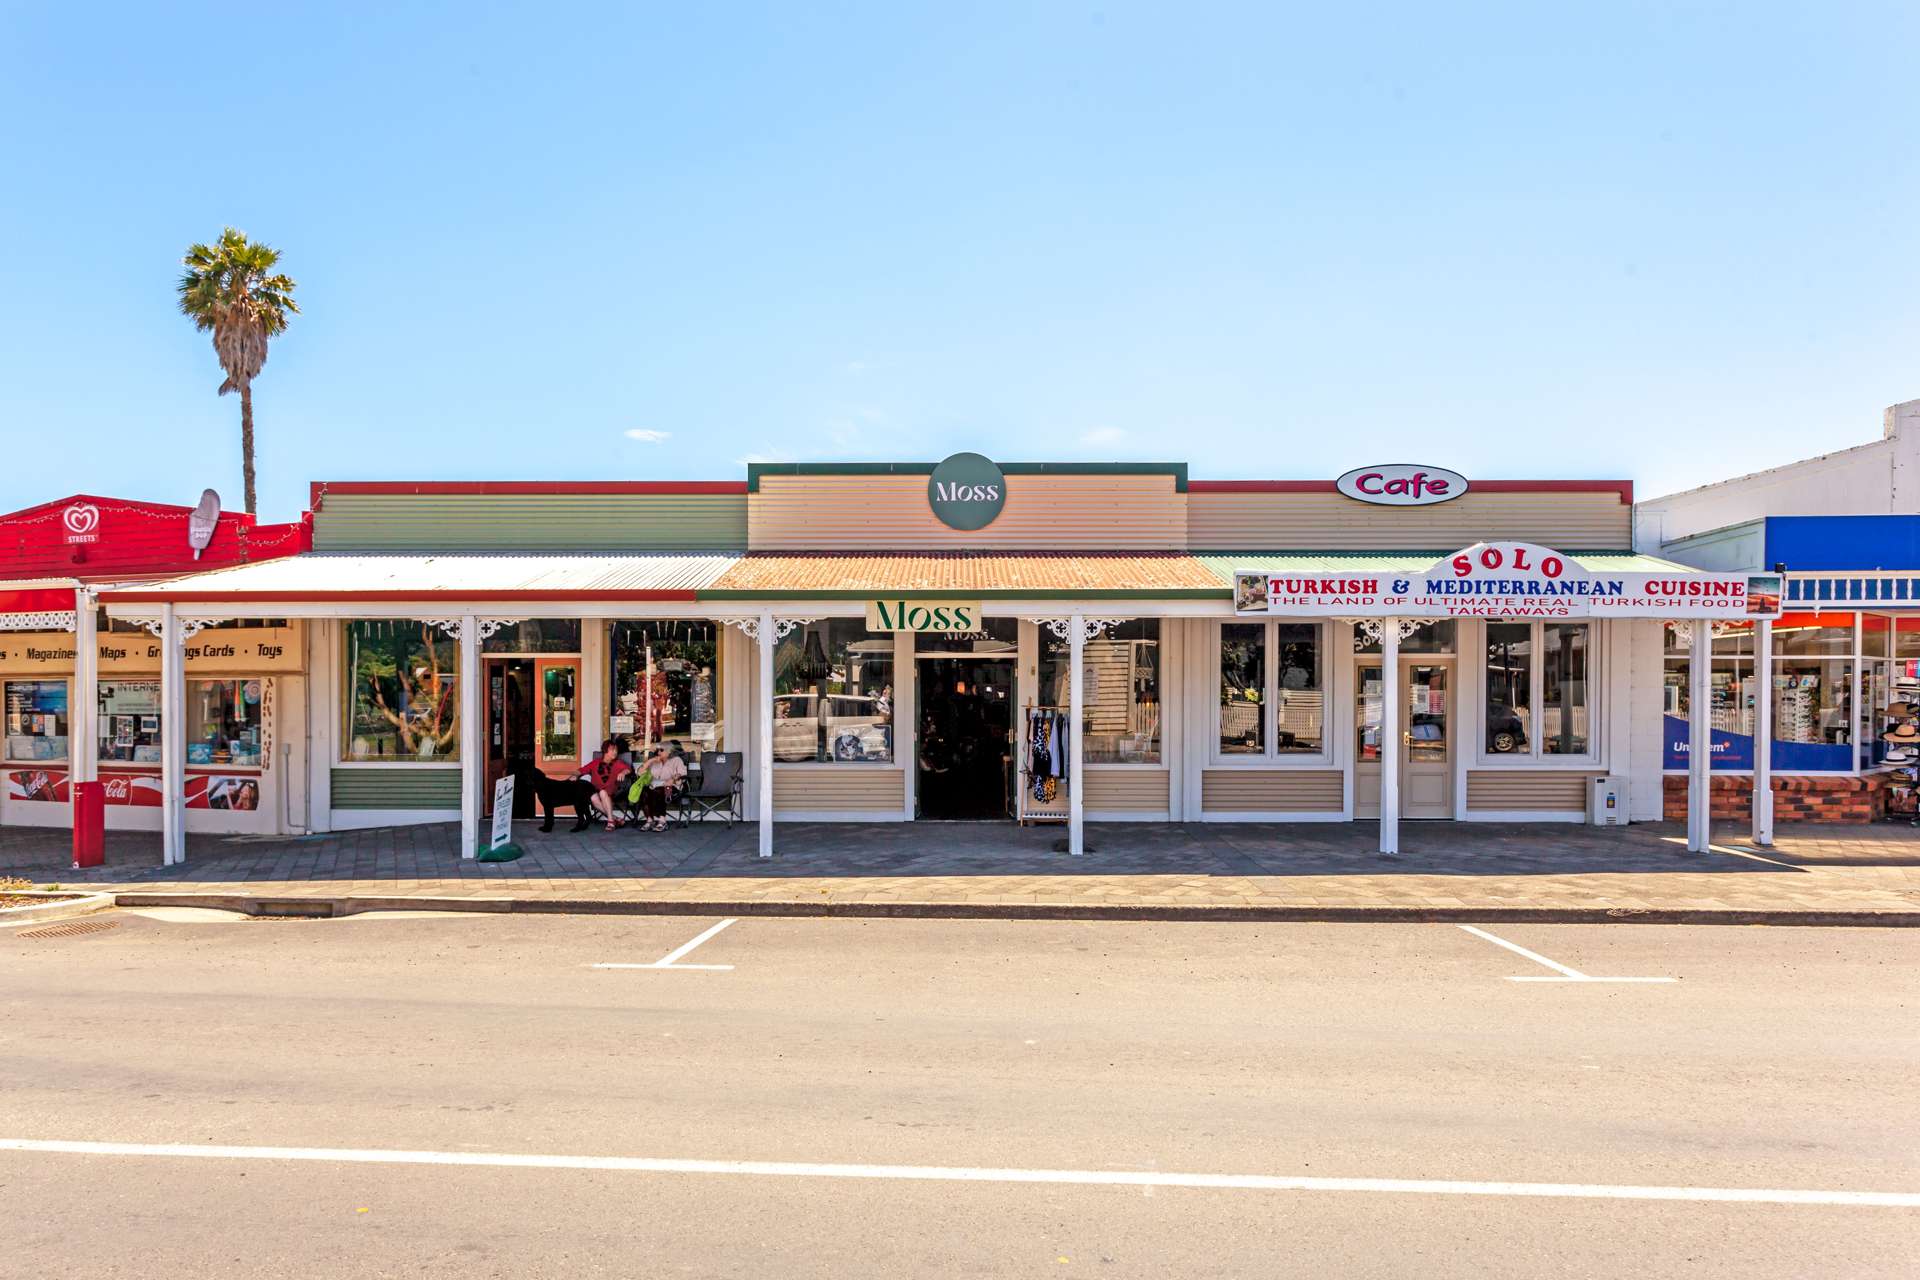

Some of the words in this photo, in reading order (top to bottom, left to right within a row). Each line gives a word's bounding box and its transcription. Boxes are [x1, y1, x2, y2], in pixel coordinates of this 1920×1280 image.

[1355, 472, 1450, 499] Cafe
[67, 535, 96, 543] STREETS
[1452, 547, 1564, 578] SOLO
[1269, 579, 1379, 595] TURKISH
[1391, 579, 1410, 594] &
[1426, 579, 1624, 595] MEDITERRANEAN
[1644, 580, 1745, 597] CUISINE
[1269, 597, 1311, 605] THE
[1317, 597, 1375, 605] LAND
[1383, 597, 1408, 605] OF
[1414, 597, 1517, 606] ULTIMATE
[1524, 598, 1579, 606] REAL
[1588, 598, 1681, 607] TURKISH
[1689, 599, 1745, 607] FOOD
[1446, 607, 1570, 616] TAKEAWAYS
[99, 646, 127, 660] Maps
[203, 644, 235, 657] Cards
[257, 643, 283, 659] Toys
[118, 682, 160, 692] INTERNE
